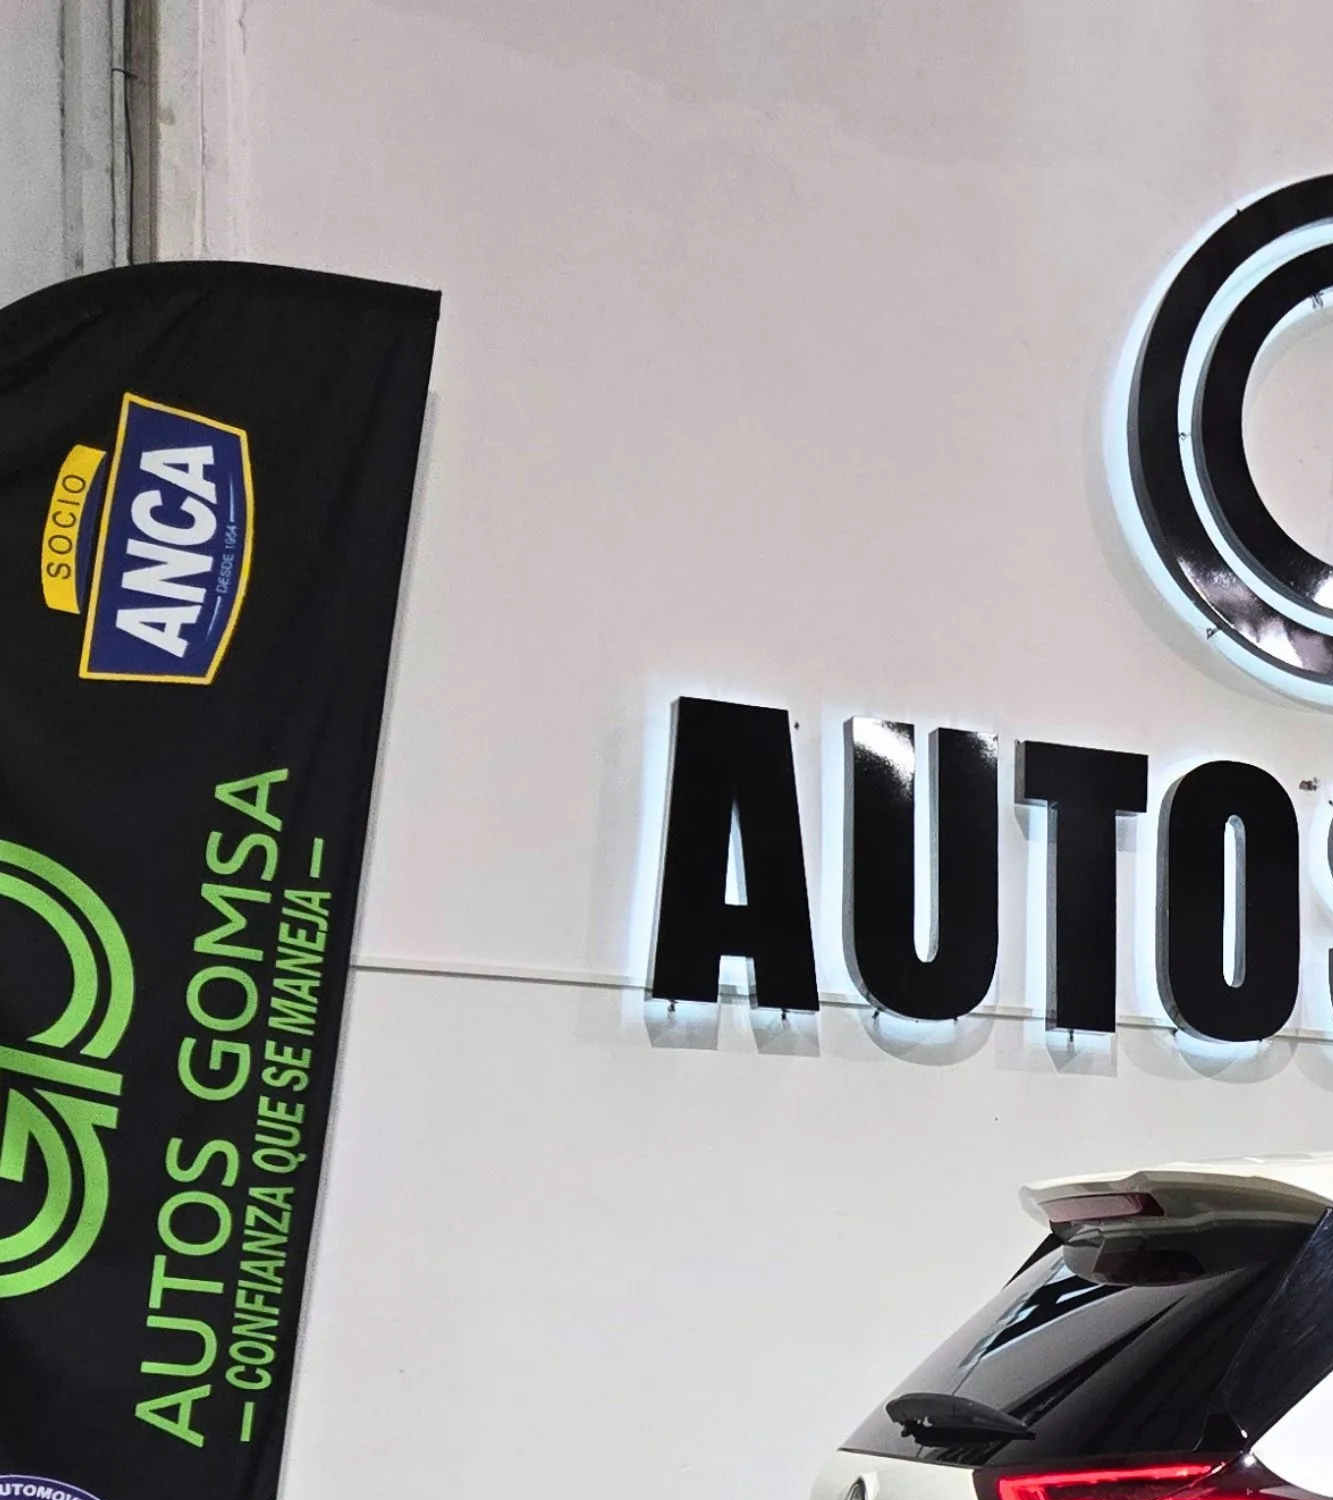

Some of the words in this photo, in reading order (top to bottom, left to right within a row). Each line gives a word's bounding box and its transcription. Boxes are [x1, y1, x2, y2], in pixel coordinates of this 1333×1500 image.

[47, 473, 87, 581] SOCIO
[115, 444, 219, 659] ANCA
[215, 553, 235, 594] DESDE
[178, 767, 290, 1101] GOMSA
[268, 888, 332, 1036] MANEJA
[252, 1095, 307, 1172] QUE
[261, 1040, 311, 1092] SE
[135, 1138, 240, 1448] AUTOS
[225, 1185, 294, 1392] CONFIANZA
